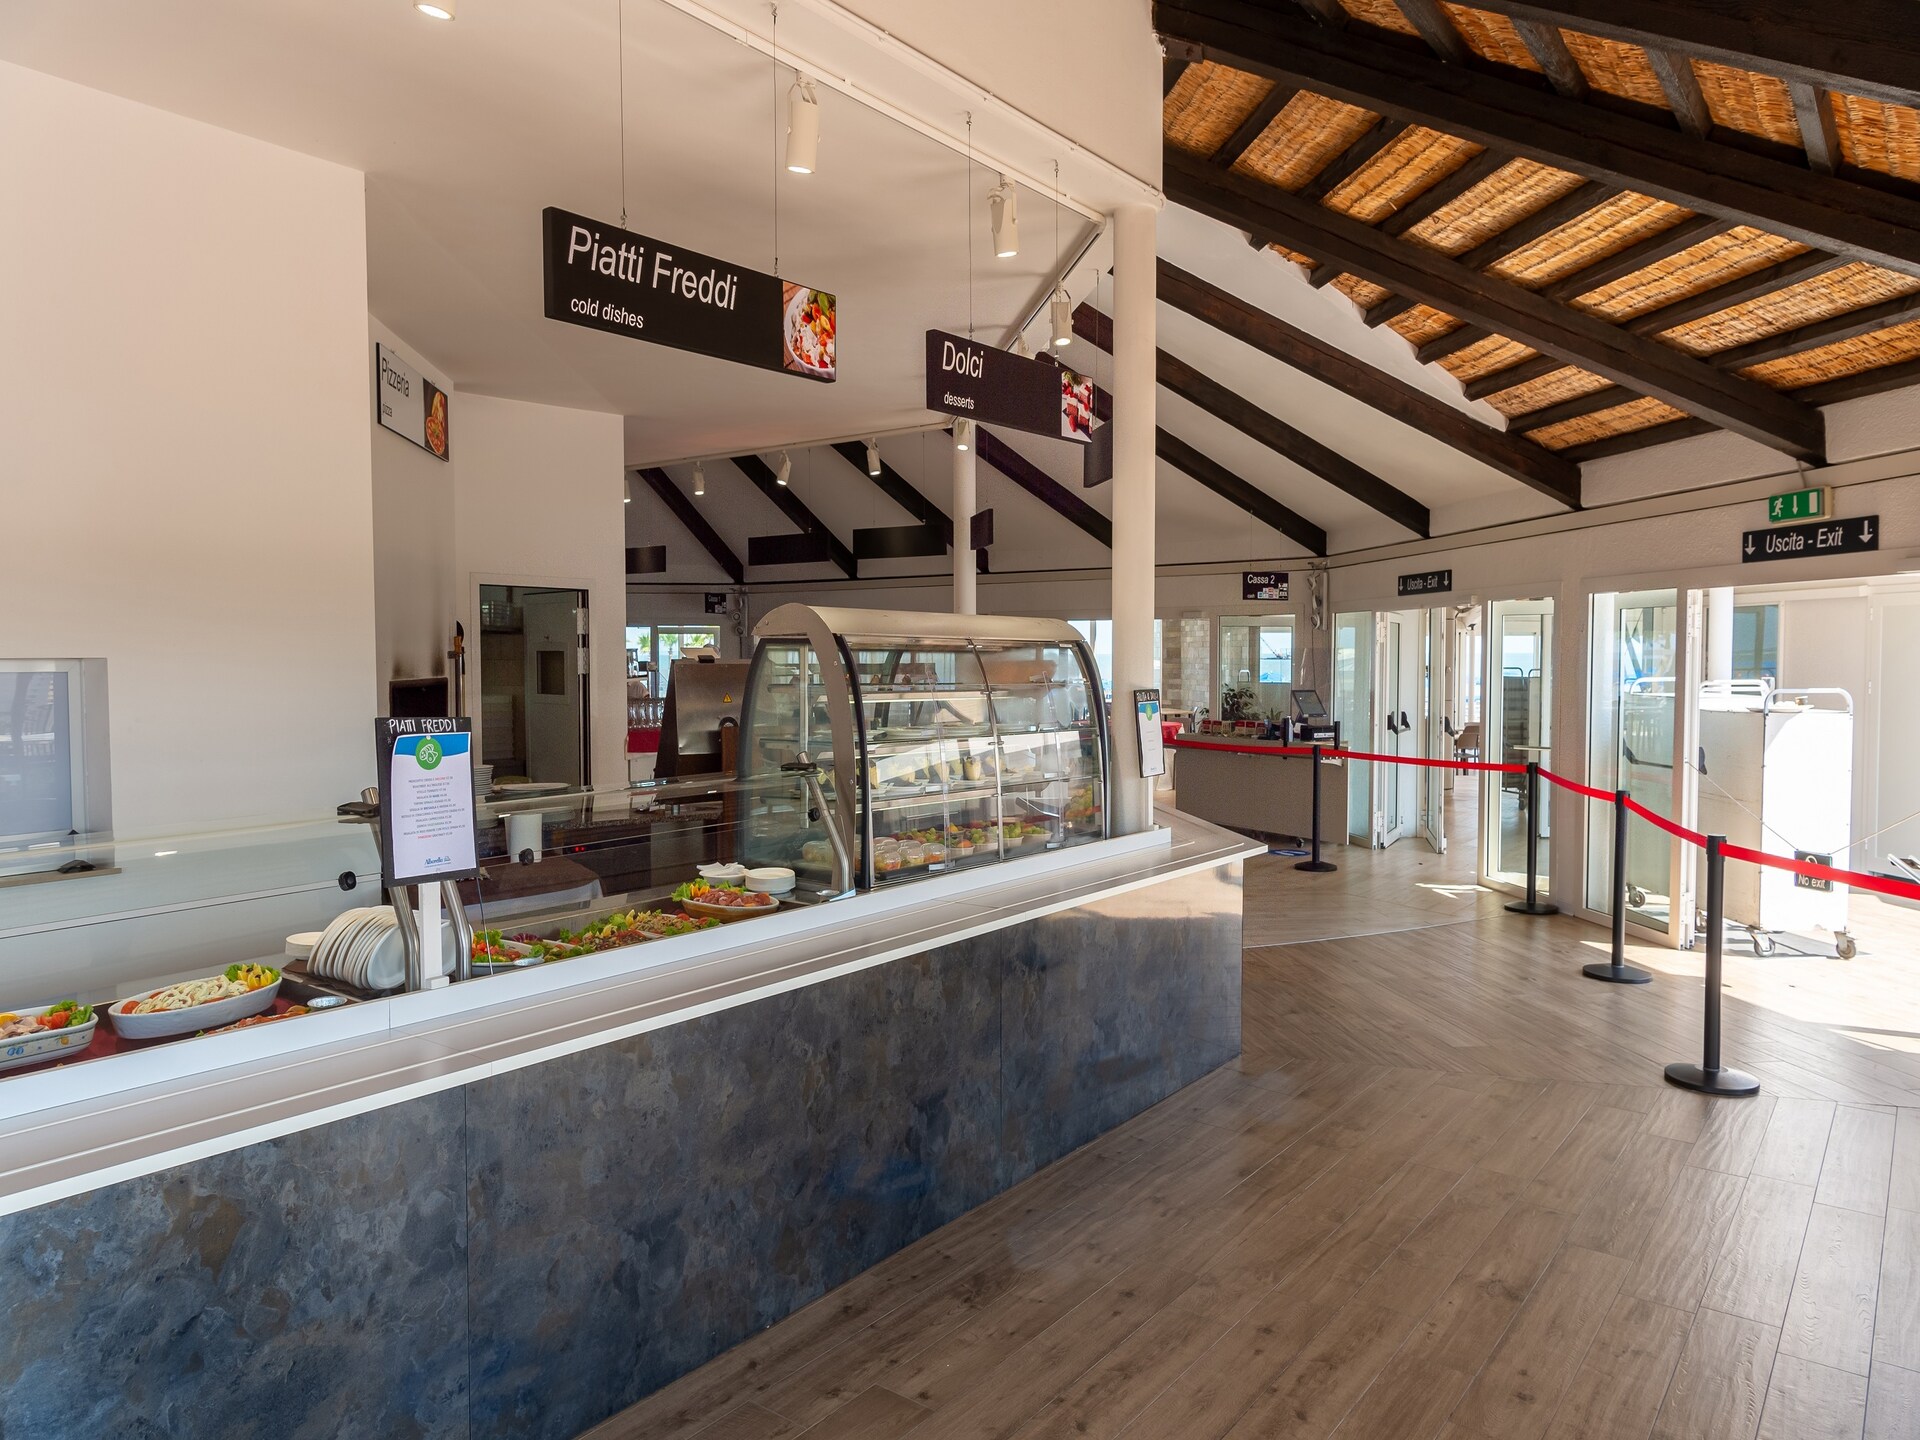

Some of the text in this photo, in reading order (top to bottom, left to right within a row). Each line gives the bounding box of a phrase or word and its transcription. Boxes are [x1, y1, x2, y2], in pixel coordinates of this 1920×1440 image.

[567, 225, 738, 311] Piatti Freddi
[570, 298, 645, 329] cold dishes
[942, 340, 984, 379] Dolci
[381, 357, 410, 398] Pizzeria
[943, 391, 975, 410] desserts
[1765, 532, 1804, 554] Uscita
[1816, 526, 1844, 548] Exit
[1247, 574, 1276, 585] Cassa 2
[1407, 577, 1423, 591] Uscita
[1427, 575, 1438, 588] Exit
[388, 718, 457, 734] PIATTI FREDDI
[1798, 873, 1826, 889] No exit
